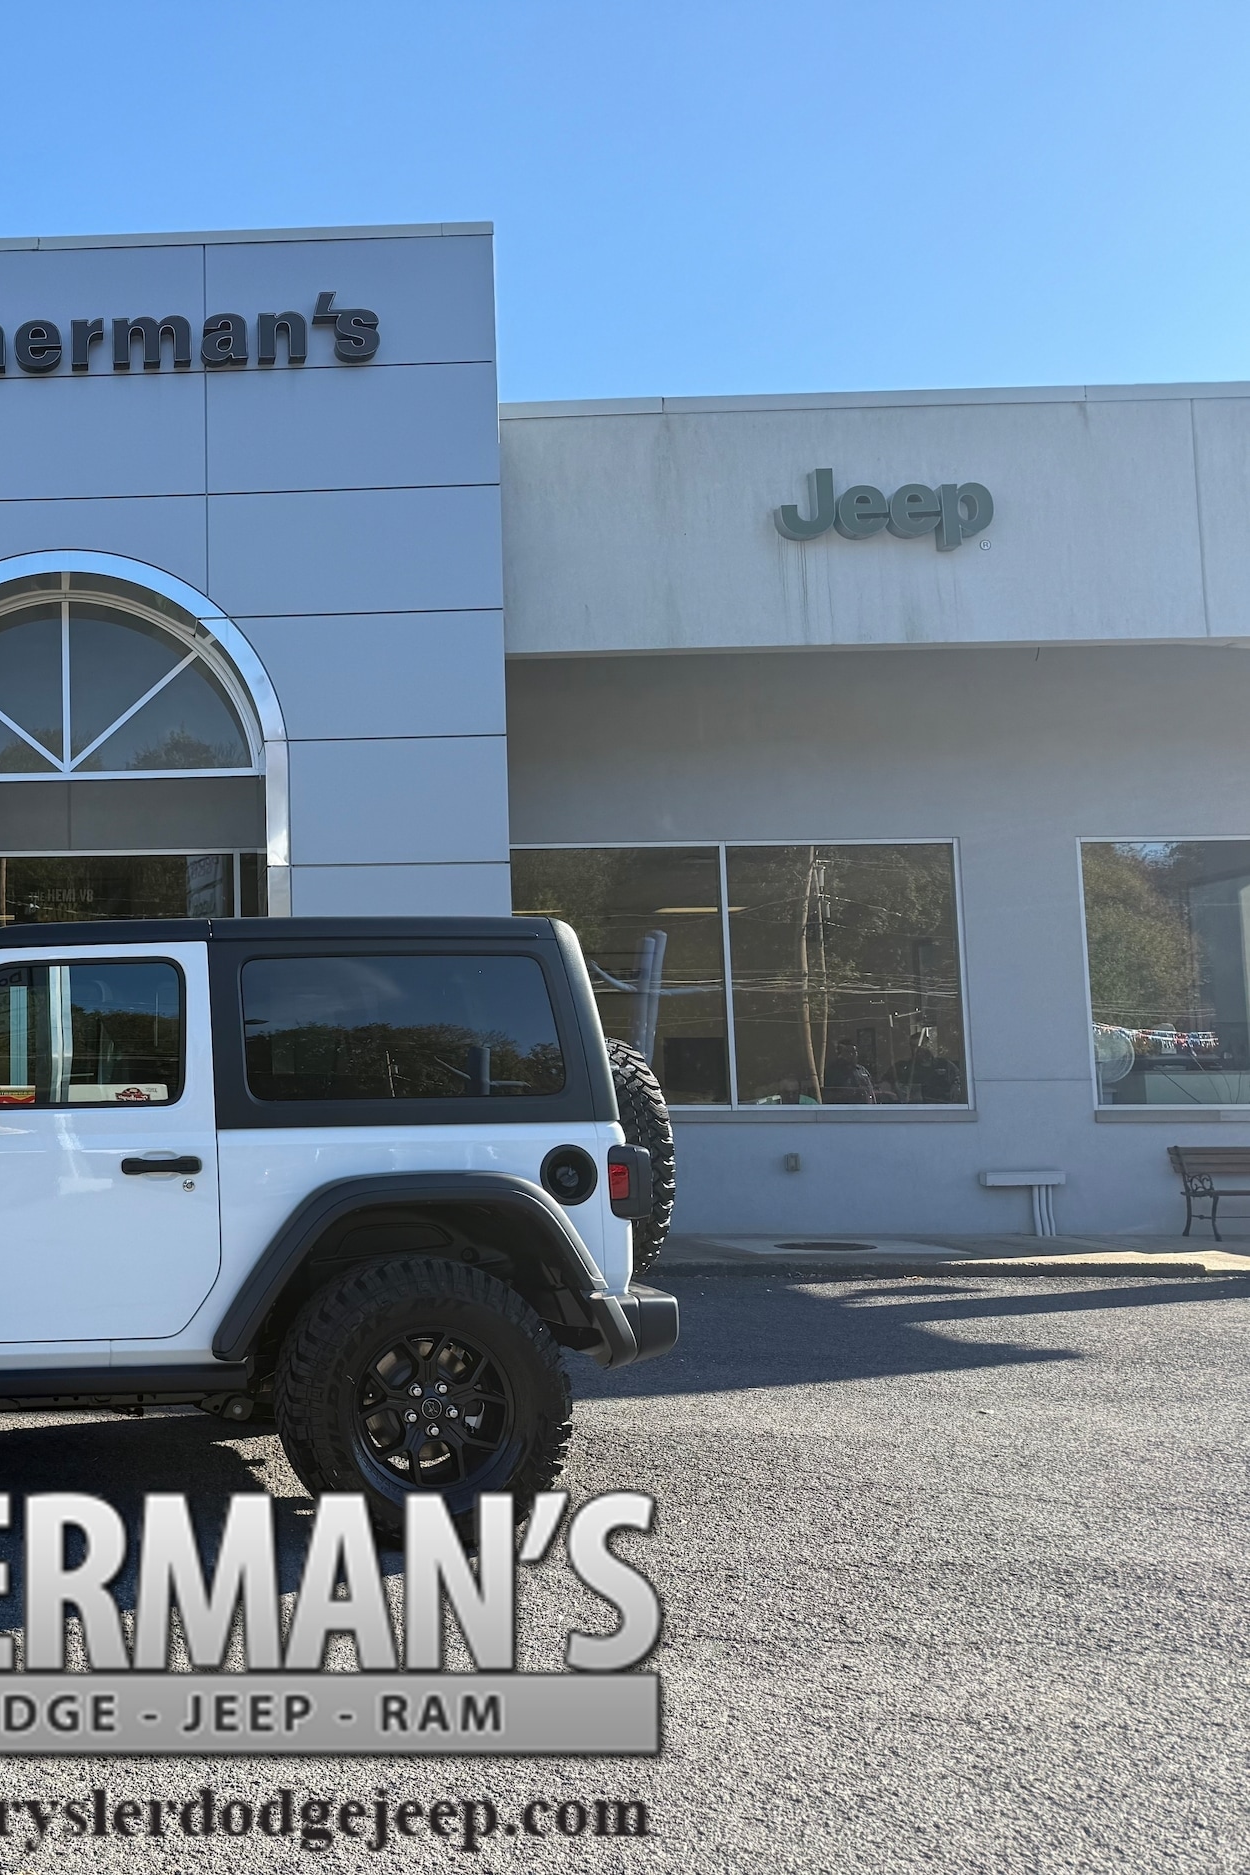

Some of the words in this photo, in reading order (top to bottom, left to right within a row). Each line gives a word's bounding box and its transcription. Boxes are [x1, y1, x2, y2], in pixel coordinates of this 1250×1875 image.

[773, 468, 994, 552] Jeep
[47, 888, 76, 902] HEMI
[79, 888, 94, 902] V8
